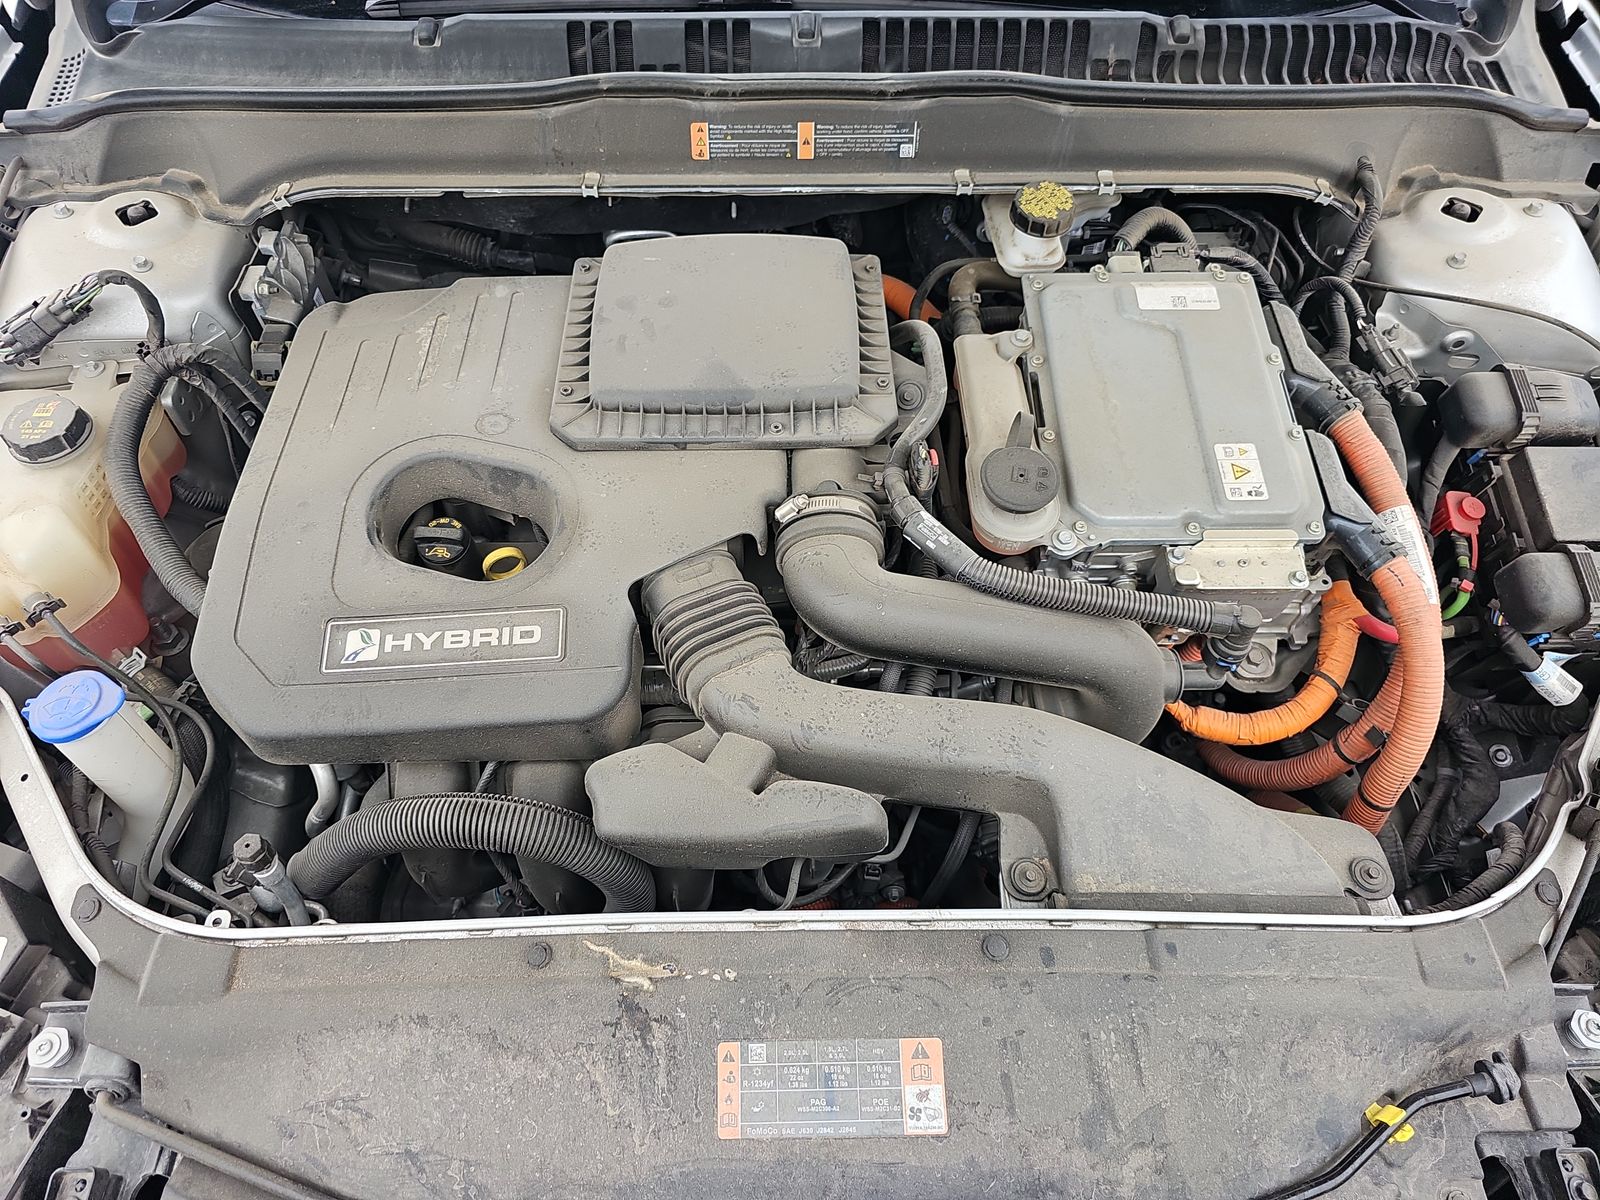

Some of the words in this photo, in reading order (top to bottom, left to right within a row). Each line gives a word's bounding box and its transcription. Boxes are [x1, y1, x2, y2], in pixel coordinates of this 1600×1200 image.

[384, 625, 542, 653] HYBRID
[801, 1067, 809, 1075] kg
[843, 1066, 850, 1074] kg
[743, 1080, 774, 1088] R-1234yf
[747, 1127, 778, 1135] FoMoCo
